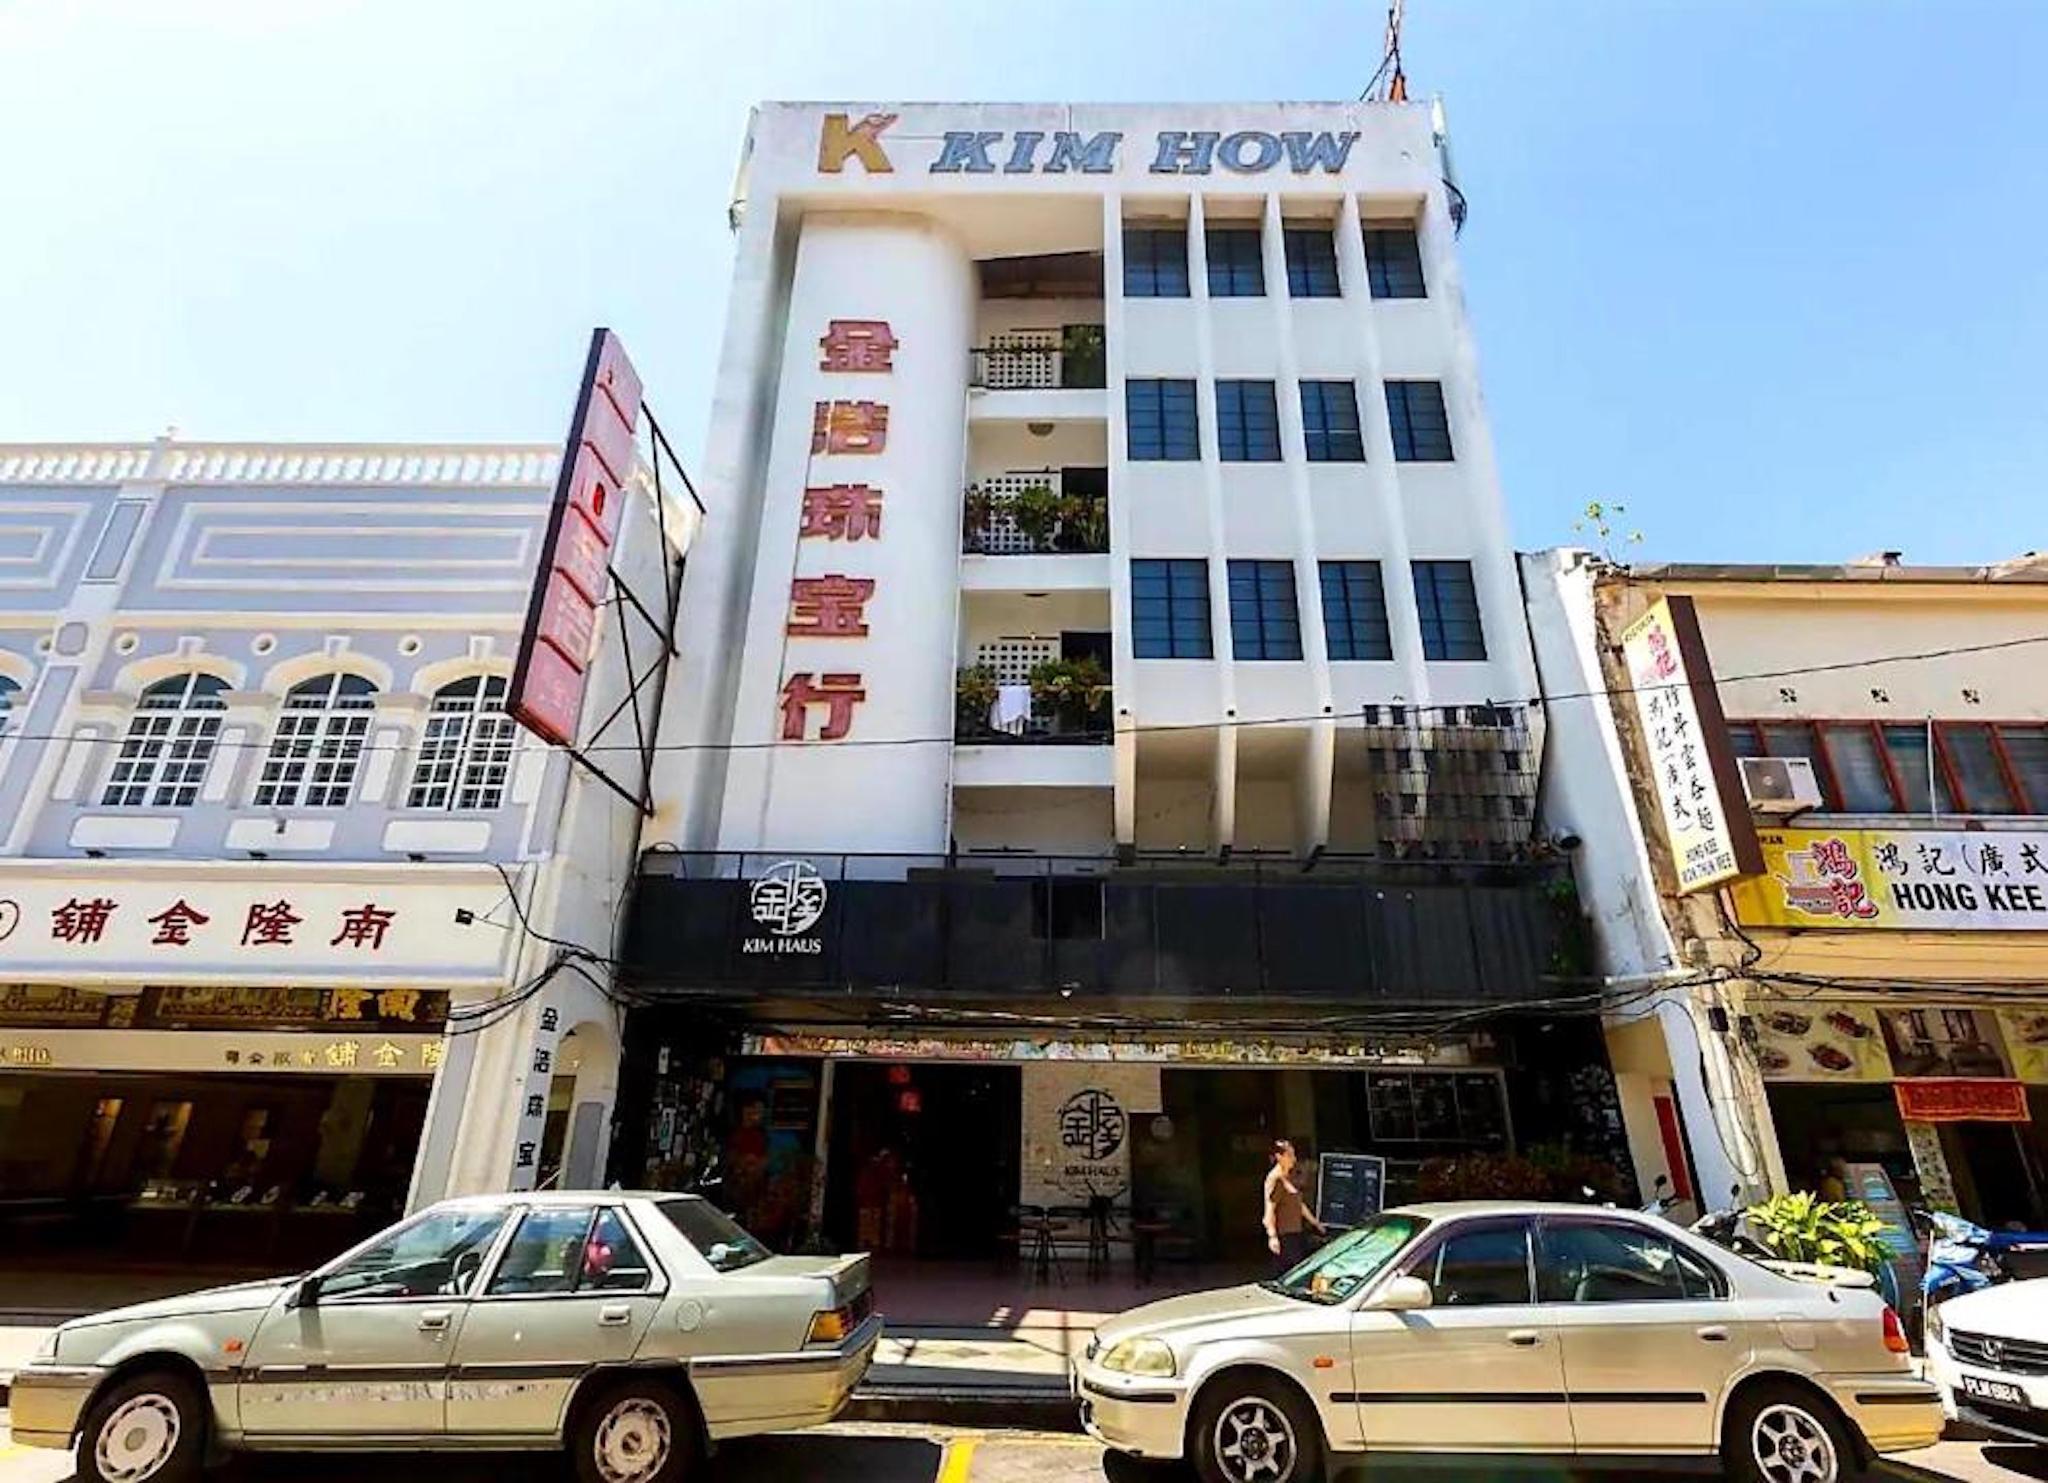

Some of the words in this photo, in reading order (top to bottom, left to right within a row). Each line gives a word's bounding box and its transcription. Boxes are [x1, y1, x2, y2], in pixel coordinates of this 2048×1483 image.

[929, 131, 1123, 174] KIM
[1149, 131, 1361, 175] HOW
[1891, 883, 1978, 910] HONG
[1984, 883, 2047, 910] KEE
[743, 938, 774, 953] KIM
[778, 938, 822, 954] HAUS
